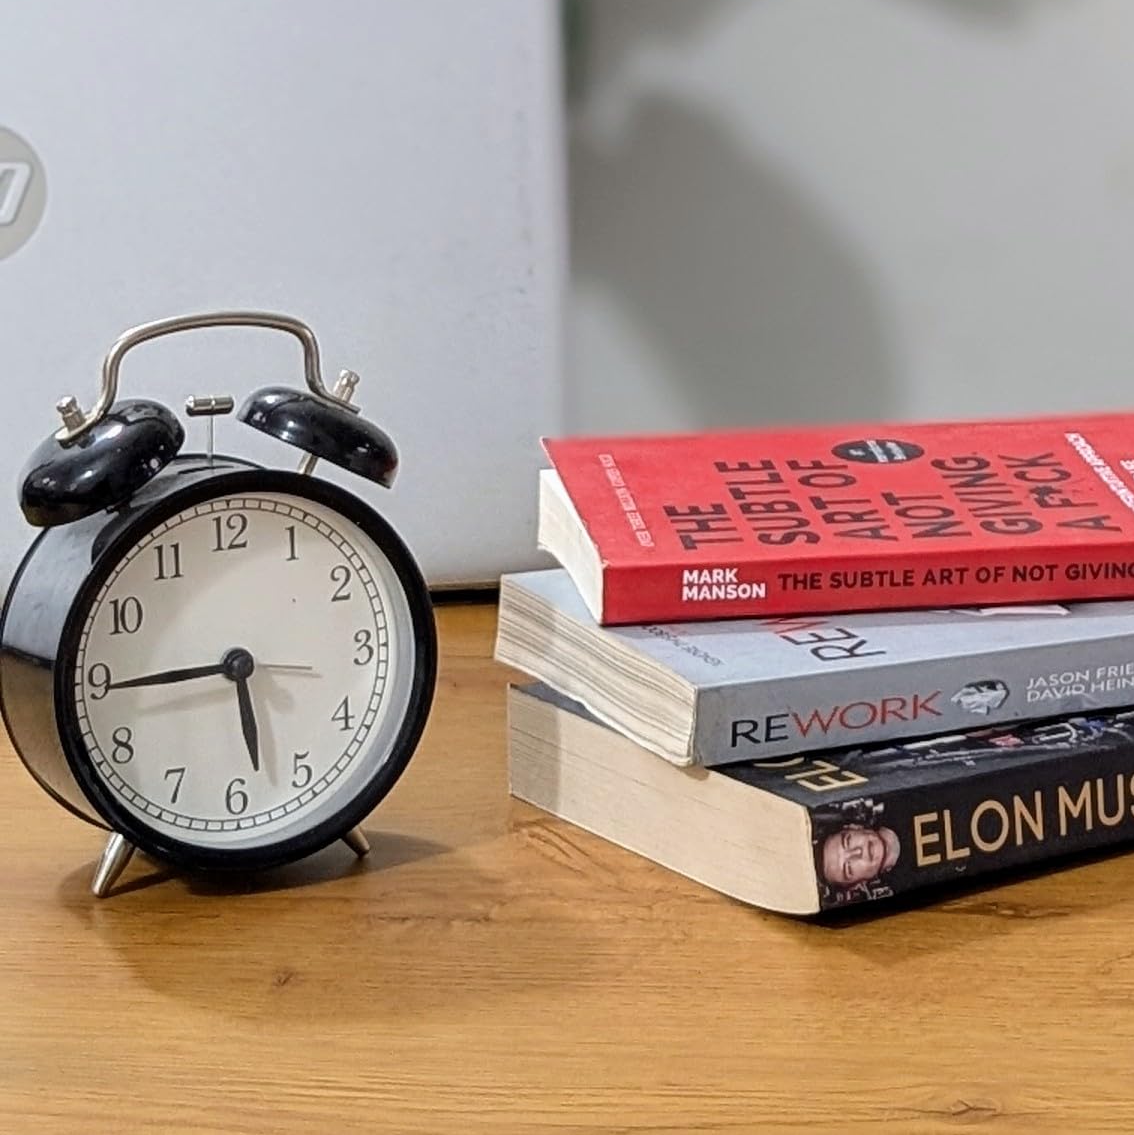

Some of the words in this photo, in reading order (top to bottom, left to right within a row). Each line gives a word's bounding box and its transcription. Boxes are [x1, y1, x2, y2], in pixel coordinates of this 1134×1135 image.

[786, 460, 857, 488] OF
[714, 460, 821, 545] SUBTLE
[930, 456, 1044, 535] GIVING
[211, 513, 248, 552] 12
[663, 503, 744, 550] THE
[808, 495, 898, 541] ART
[881, 492, 973, 539] NOT
[1056, 515, 1123, 533] A
[154, 542, 184, 580] 11
[285, 525, 299, 561] 1
[330, 565, 351, 602] 2
[682, 568, 738, 586] MARK
[682, 582, 766, 601] MANSON
[778, 572, 822, 591] THE
[829, 568, 914, 589] SUBTLE
[922, 567, 969, 587] ART
[975, 566, 1005, 584] OF
[1012, 564, 1059, 583] NOT
[108, 596, 144, 635] 10
[353, 629, 374, 666] 3
[760, 617, 886, 661] REW
[88, 663, 112, 700] 9
[1026, 669, 1090, 690] JASON
[1027, 683, 1085, 704] DAVID
[332, 696, 355, 731] 4
[730, 691, 943, 748] REWORK
[112, 726, 135, 765] 8
[164, 767, 186, 804] 7
[292, 751, 312, 788] 5
[225, 778, 248, 815] 6
[913, 790, 1045, 867] ELON
